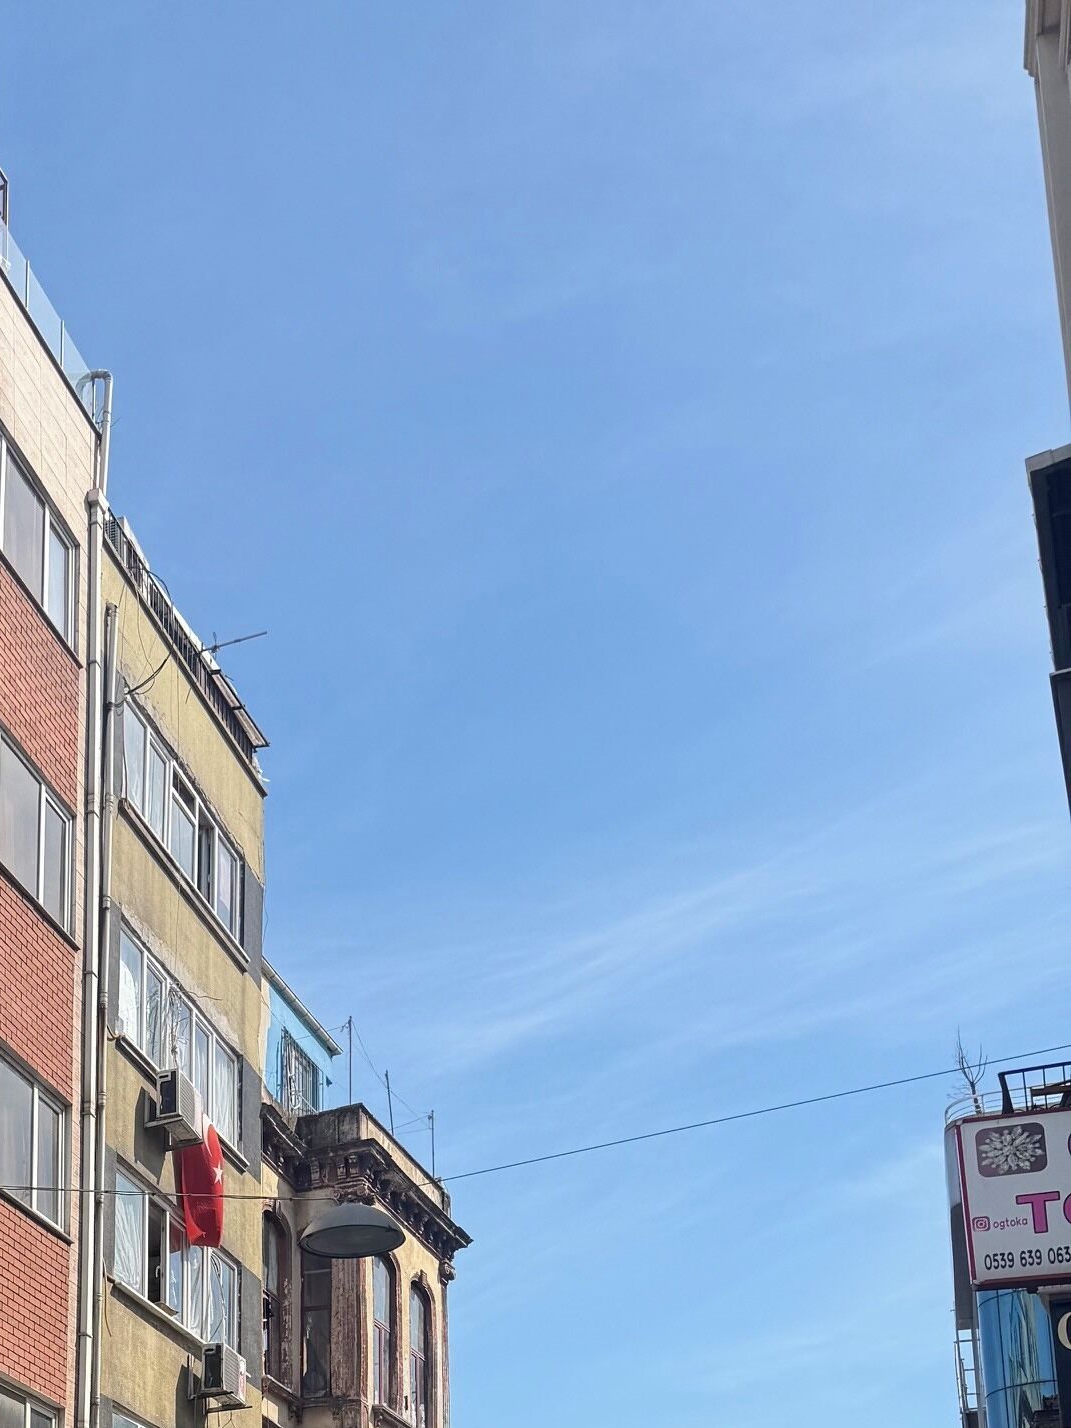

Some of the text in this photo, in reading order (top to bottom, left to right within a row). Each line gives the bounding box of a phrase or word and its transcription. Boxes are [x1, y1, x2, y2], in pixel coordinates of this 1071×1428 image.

[1015, 1190, 1071, 1234] T
[993, 1217, 1028, 1230] ogtoka
[984, 1252, 1015, 1270] 0539
[1020, 1249, 1042, 1268] 639
